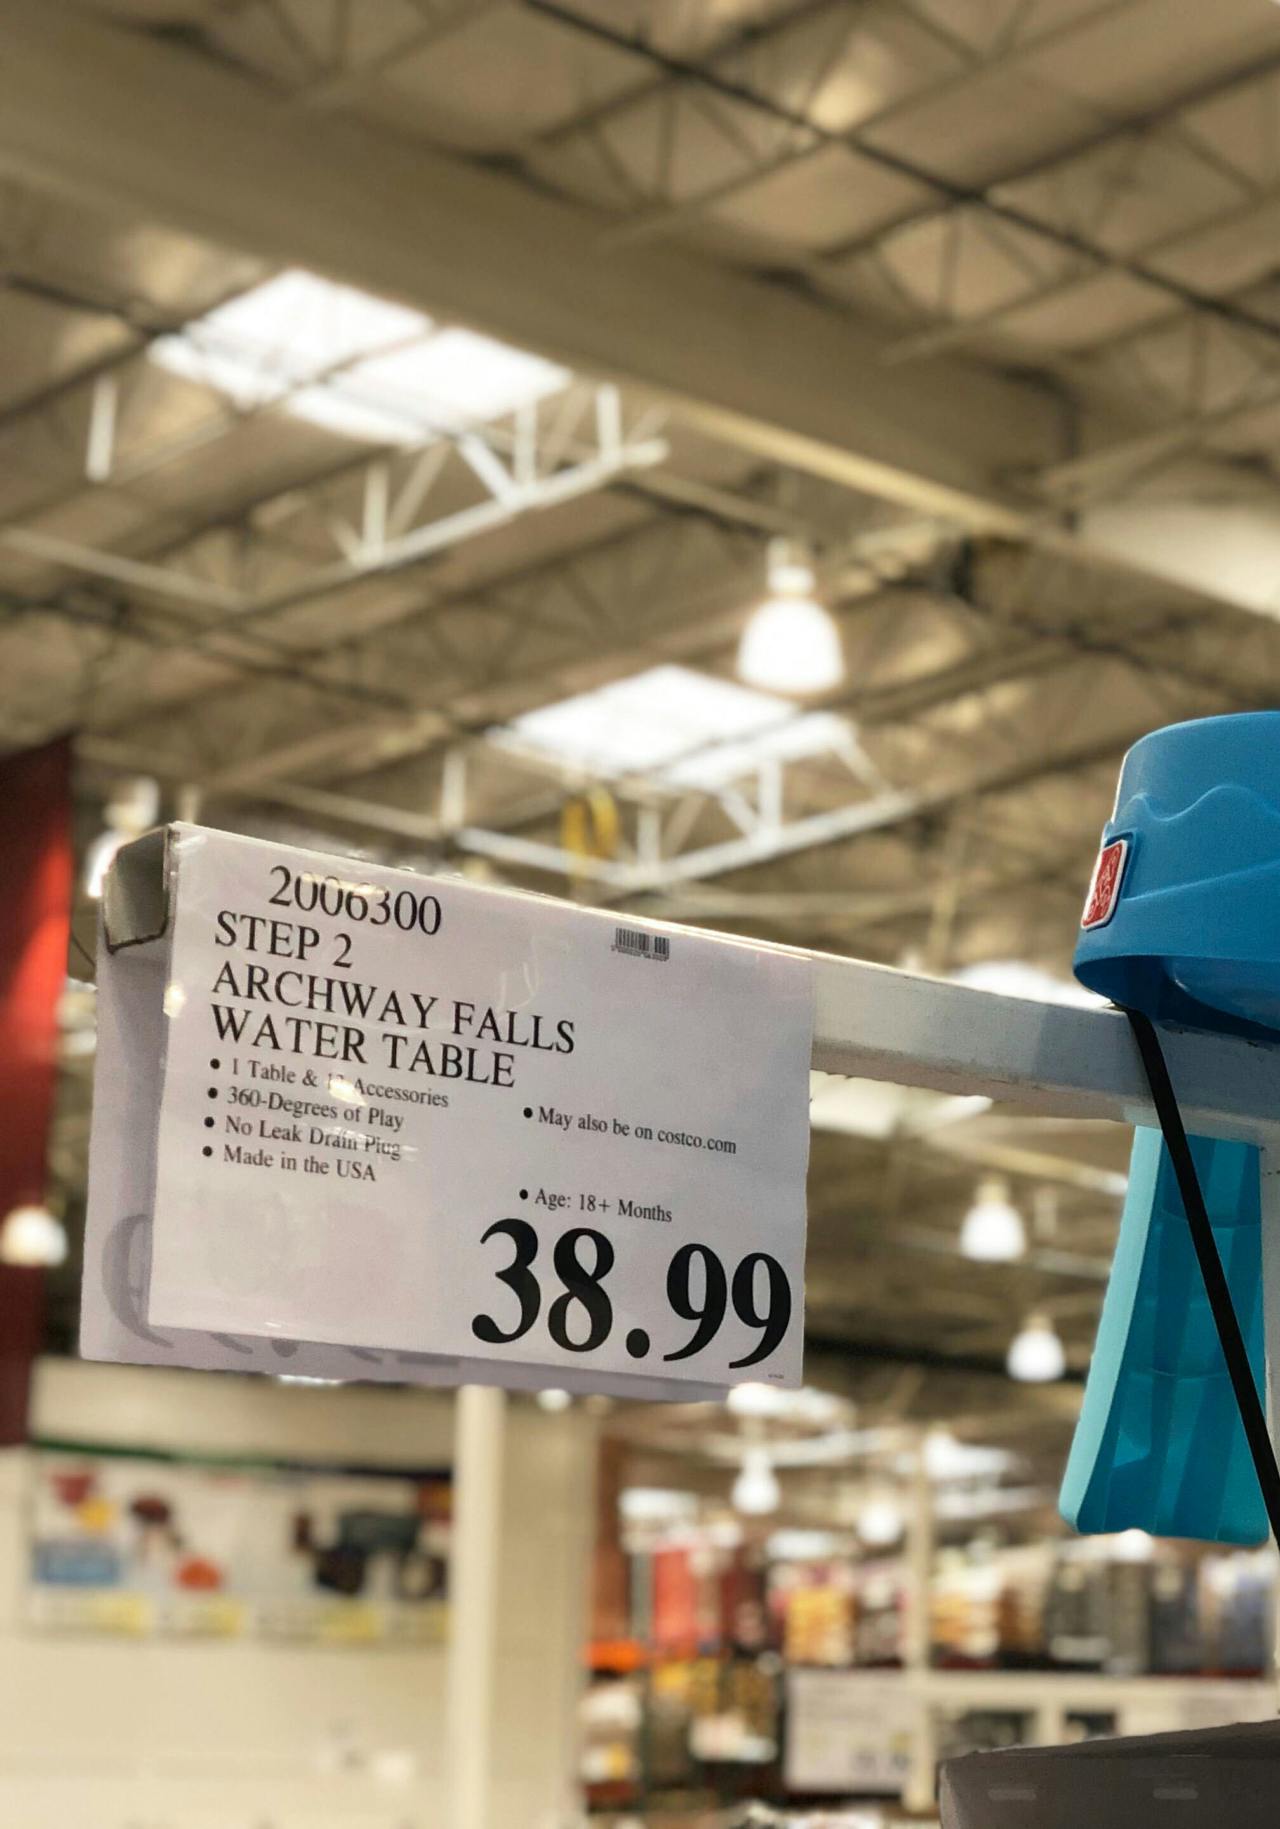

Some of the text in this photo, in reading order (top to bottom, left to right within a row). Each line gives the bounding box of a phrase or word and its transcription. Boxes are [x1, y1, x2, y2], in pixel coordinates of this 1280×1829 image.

[268, 866, 442, 935] 2006300
[215, 910, 354, 969] STEP 2
[211, 961, 575, 1054] ARCHWAY FALLS
[211, 1004, 516, 1088] WATER TABLE
[232, 1058, 239, 1075] 1
[248, 1060, 298, 1084] Table
[302, 1069, 319, 1087] &
[354, 1078, 450, 1108] Accessories
[225, 1115, 253, 1136] No
[259, 1120, 302, 1143] Leak
[310, 1127, 358, 1151] Drain
[227, 1087, 404, 1133] 360-Degrees of Play
[539, 1107, 737, 1154] May also be on costco.com
[224, 1144, 377, 1182] Made in the USA
[534, 1188, 673, 1223] Age: 18+ Months
[472, 1218, 791, 1369] 38.99
